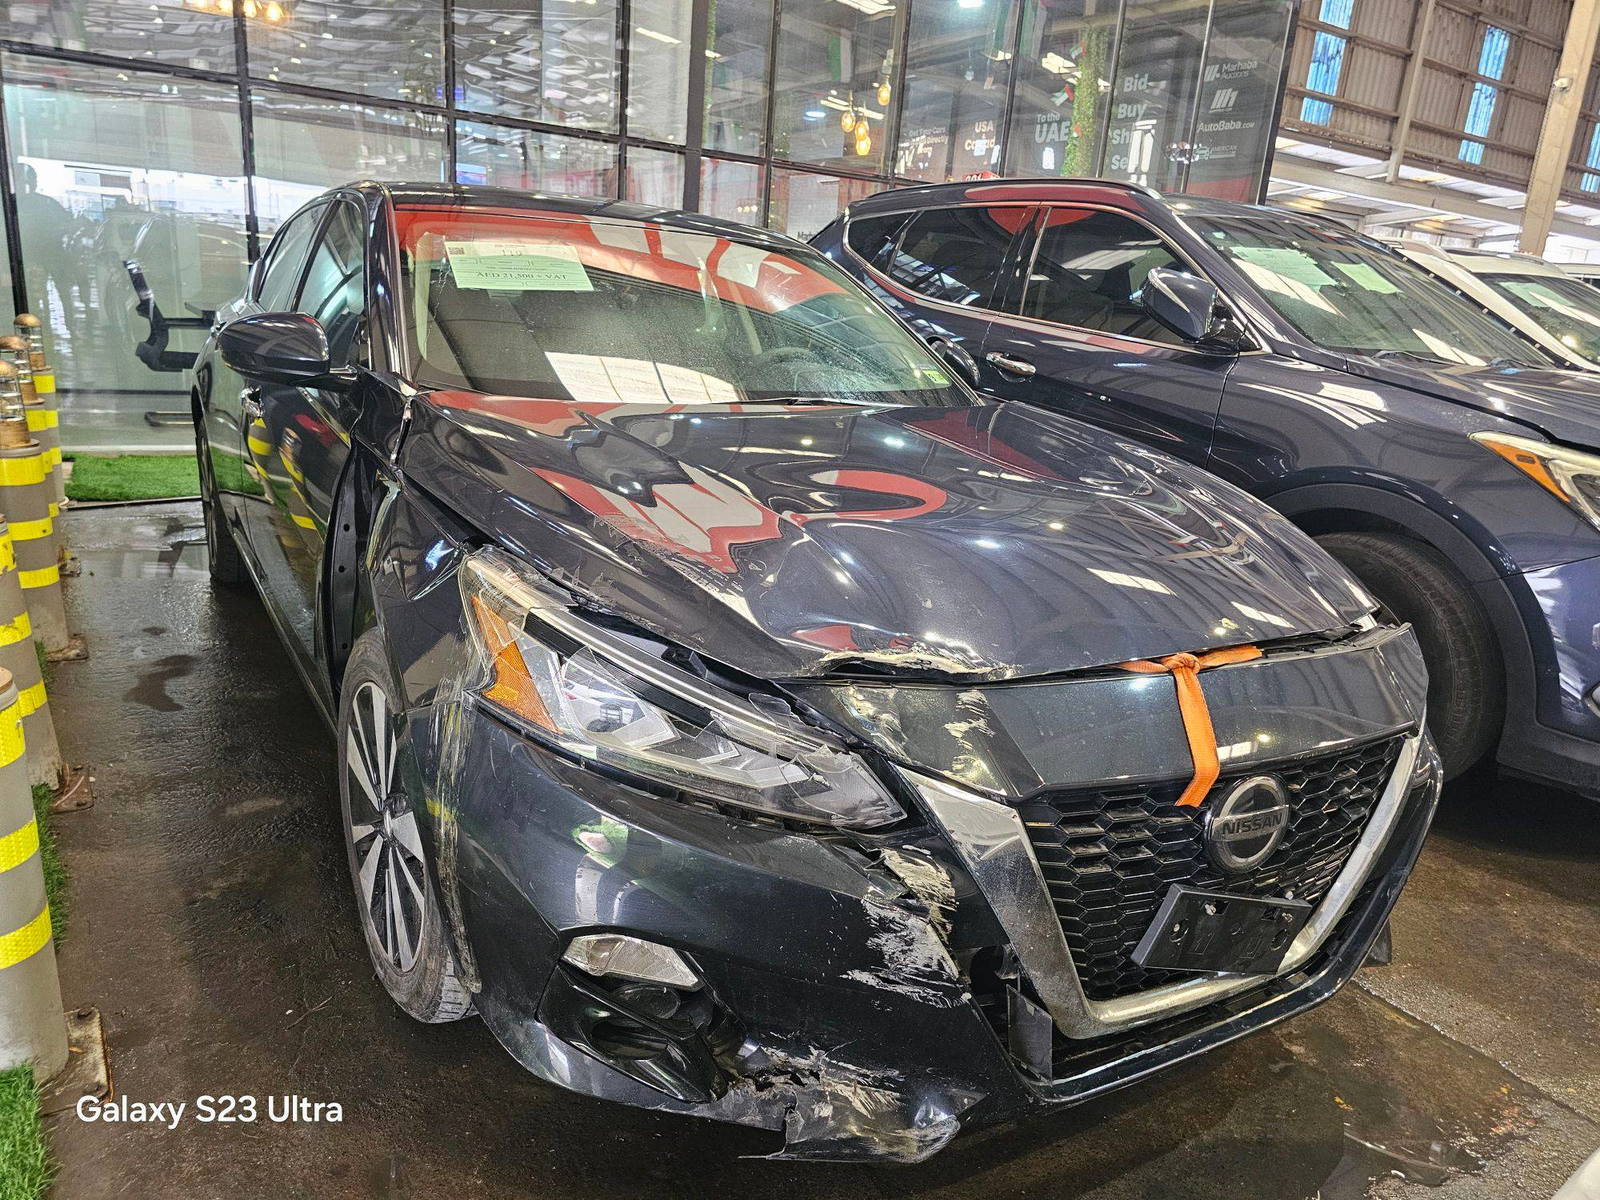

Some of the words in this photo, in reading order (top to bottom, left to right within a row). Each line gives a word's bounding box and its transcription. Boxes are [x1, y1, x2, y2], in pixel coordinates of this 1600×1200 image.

[1123, 74, 1149, 92] Bid
[1117, 103, 1147, 121] Buy
[974, 119, 993, 133] USA
[1035, 120, 1071, 144] UAE
[545, 273, 568, 281] VAT
[1222, 812, 1282, 836] NISSAN
